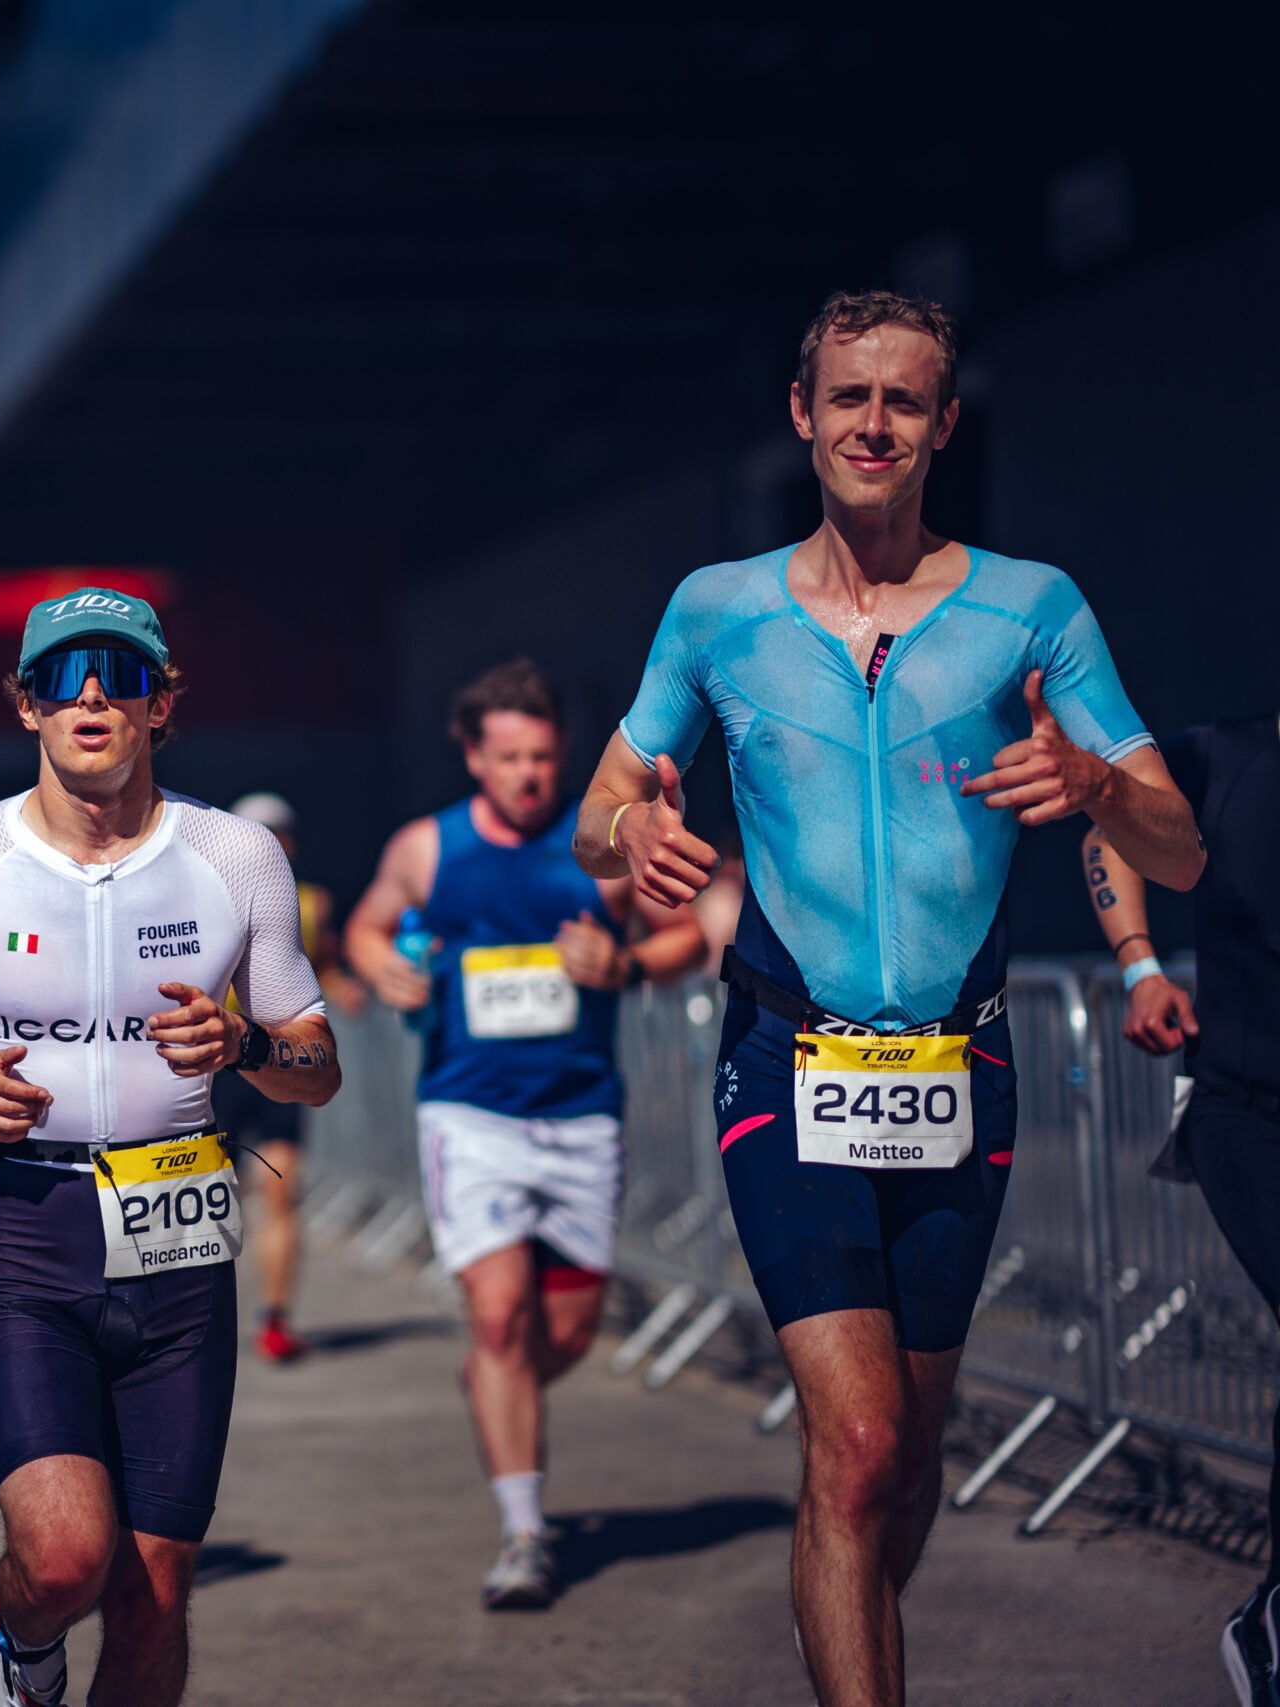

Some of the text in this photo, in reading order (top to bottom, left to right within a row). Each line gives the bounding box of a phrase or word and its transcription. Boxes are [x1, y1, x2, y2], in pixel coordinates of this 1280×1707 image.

[46, 594, 132, 616] T100
[138, 920, 198, 941] FOURIER
[139, 940, 201, 959] CYCLING
[857, 1048, 916, 1062] T100
[719, 1061, 739, 1112] RYSEL
[813, 1082, 958, 1125] 2430
[162, 1146, 188, 1154] LONDON
[848, 1143, 924, 1160] Matteo
[151, 1151, 198, 1170] T100
[161, 1167, 193, 1177] TRIATHLON
[122, 1181, 231, 1236] 2109
[141, 1241, 221, 1268] Riccardo
